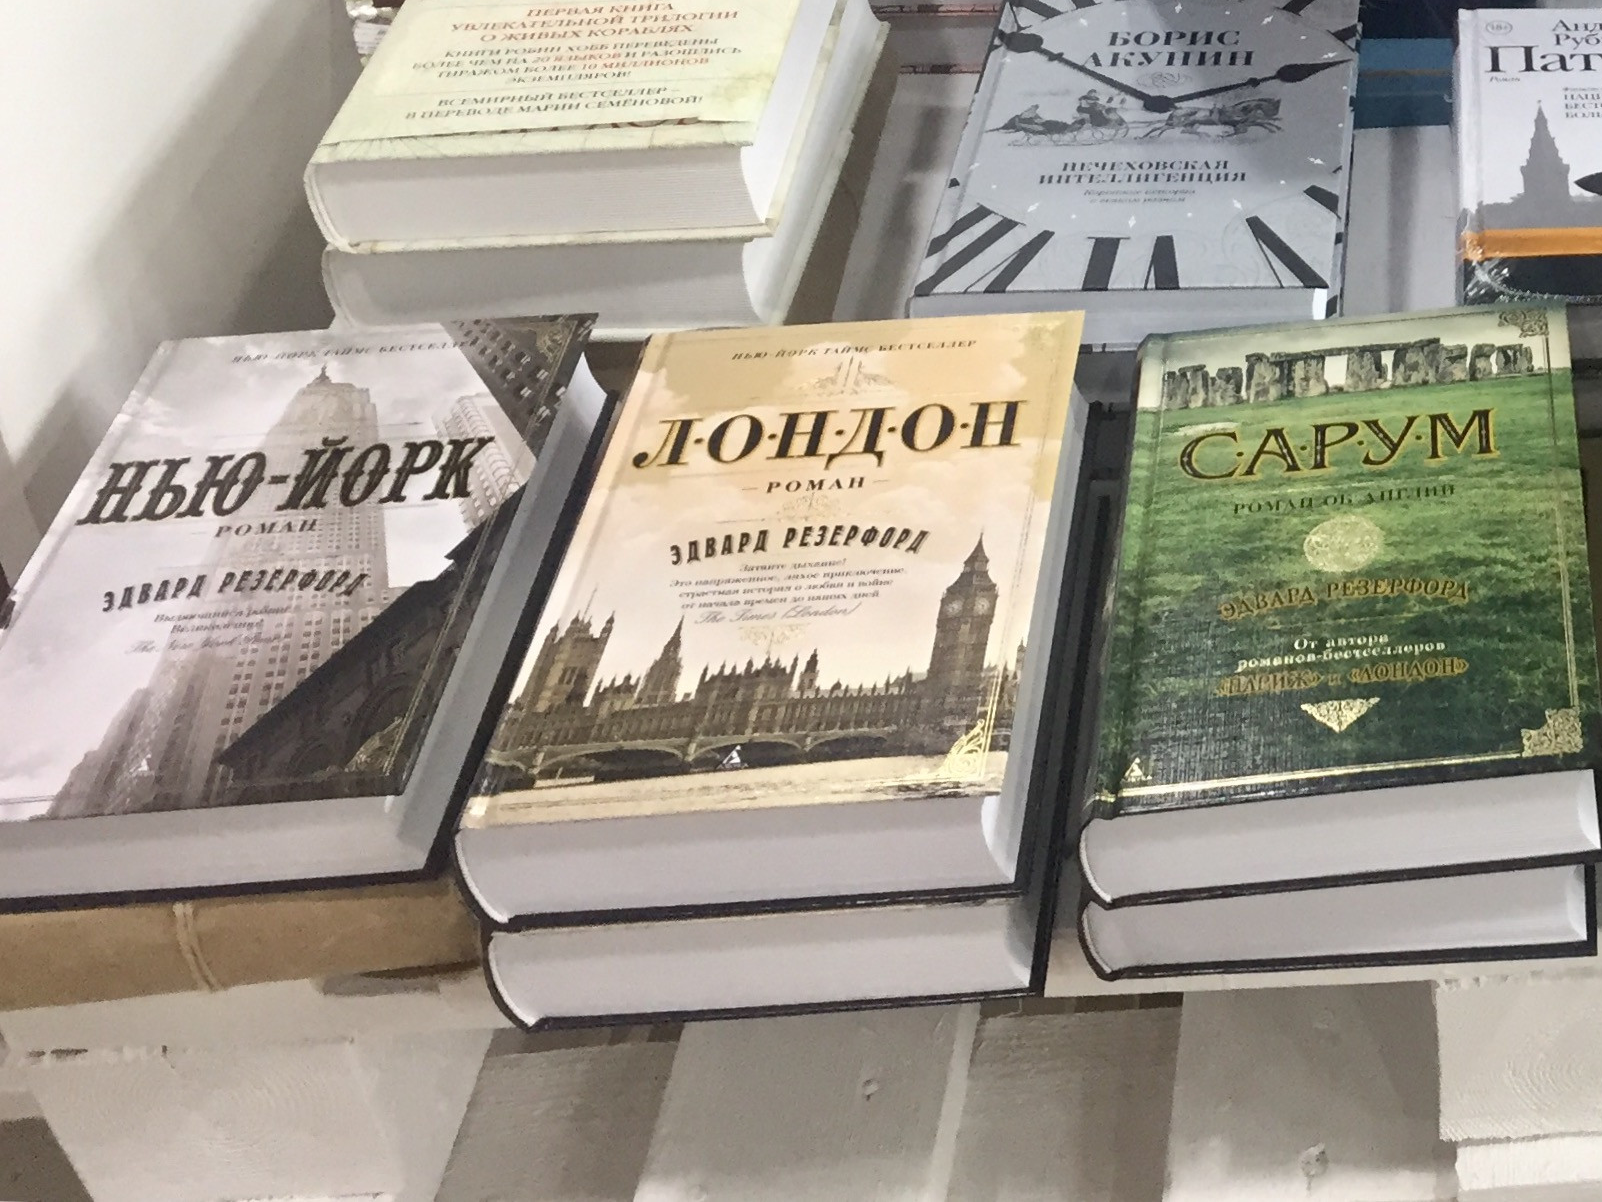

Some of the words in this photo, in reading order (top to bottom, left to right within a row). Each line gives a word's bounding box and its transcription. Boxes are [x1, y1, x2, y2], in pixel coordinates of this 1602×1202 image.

[527, 7, 598, 18] ПЕРВАЯ
[601, 4, 674, 14] КНИГА
[451, 16, 625, 32] УВЛЕКАТЕЛЬНОЙ
[629, 11, 739, 24] ТРИЛОГИИ
[500, 30, 583, 42] ЖИВЫХ
[587, 24, 694, 38] КОРАБЛЯХ
[1107, 30, 1241, 47] БОРИС
[1083, 50, 1254, 68] АКУНИН
[438, 92, 553, 107] ВСЕМИРНЫЙ
[557, 87, 667, 100] БЕСТСЕЛЛЕР
[1062, 160, 1229, 171] НЕЧЕХОВСКАЯ
[1039, 172, 1247, 184] ИНТЕЛЛИГЕНЦИЯ
[77, 435, 495, 525] НЬЮ-ЙОРК
[766, 476, 866, 493] РОМАН
[1234, 498, 1316, 516] РОМАН
[214, 519, 320, 539] РОМАН
[669, 529, 769, 566] ЭДВАРД
[783, 525, 930, 554] РЕЗЕРФОРД
[102, 574, 207, 612] ЭДВАРД
[217, 568, 369, 596] РЕЗЕРФОРД
[1219, 585, 1318, 620] ЭДВАРД
[1326, 579, 1471, 601] РЕЗЕРФОРД
[1293, 636, 1316, 651] От
[1326, 631, 1390, 650] автора
